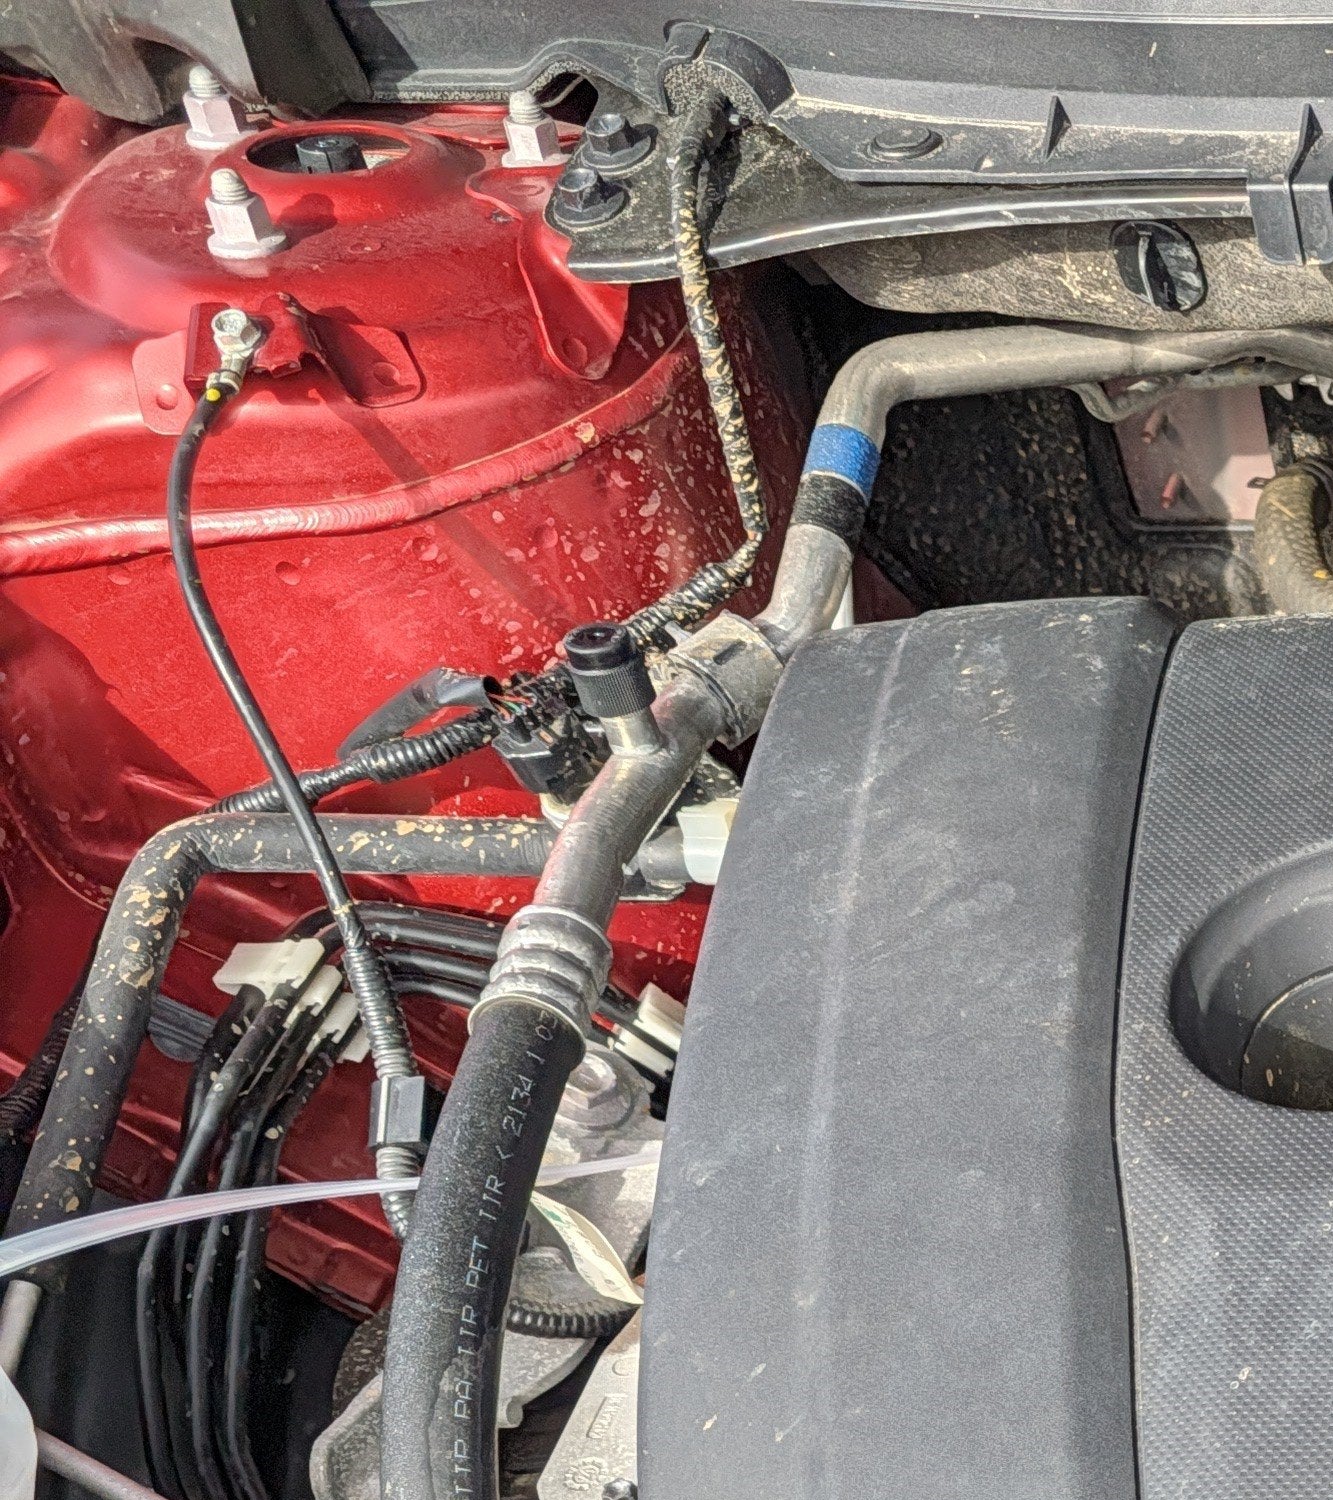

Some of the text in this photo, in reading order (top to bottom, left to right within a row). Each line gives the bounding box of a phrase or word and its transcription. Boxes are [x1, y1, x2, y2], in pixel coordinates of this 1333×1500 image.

[465, 1235, 490, 1288] PET
[479, 1174, 508, 1222] IIR
[502, 1074, 534, 1137] 2134
